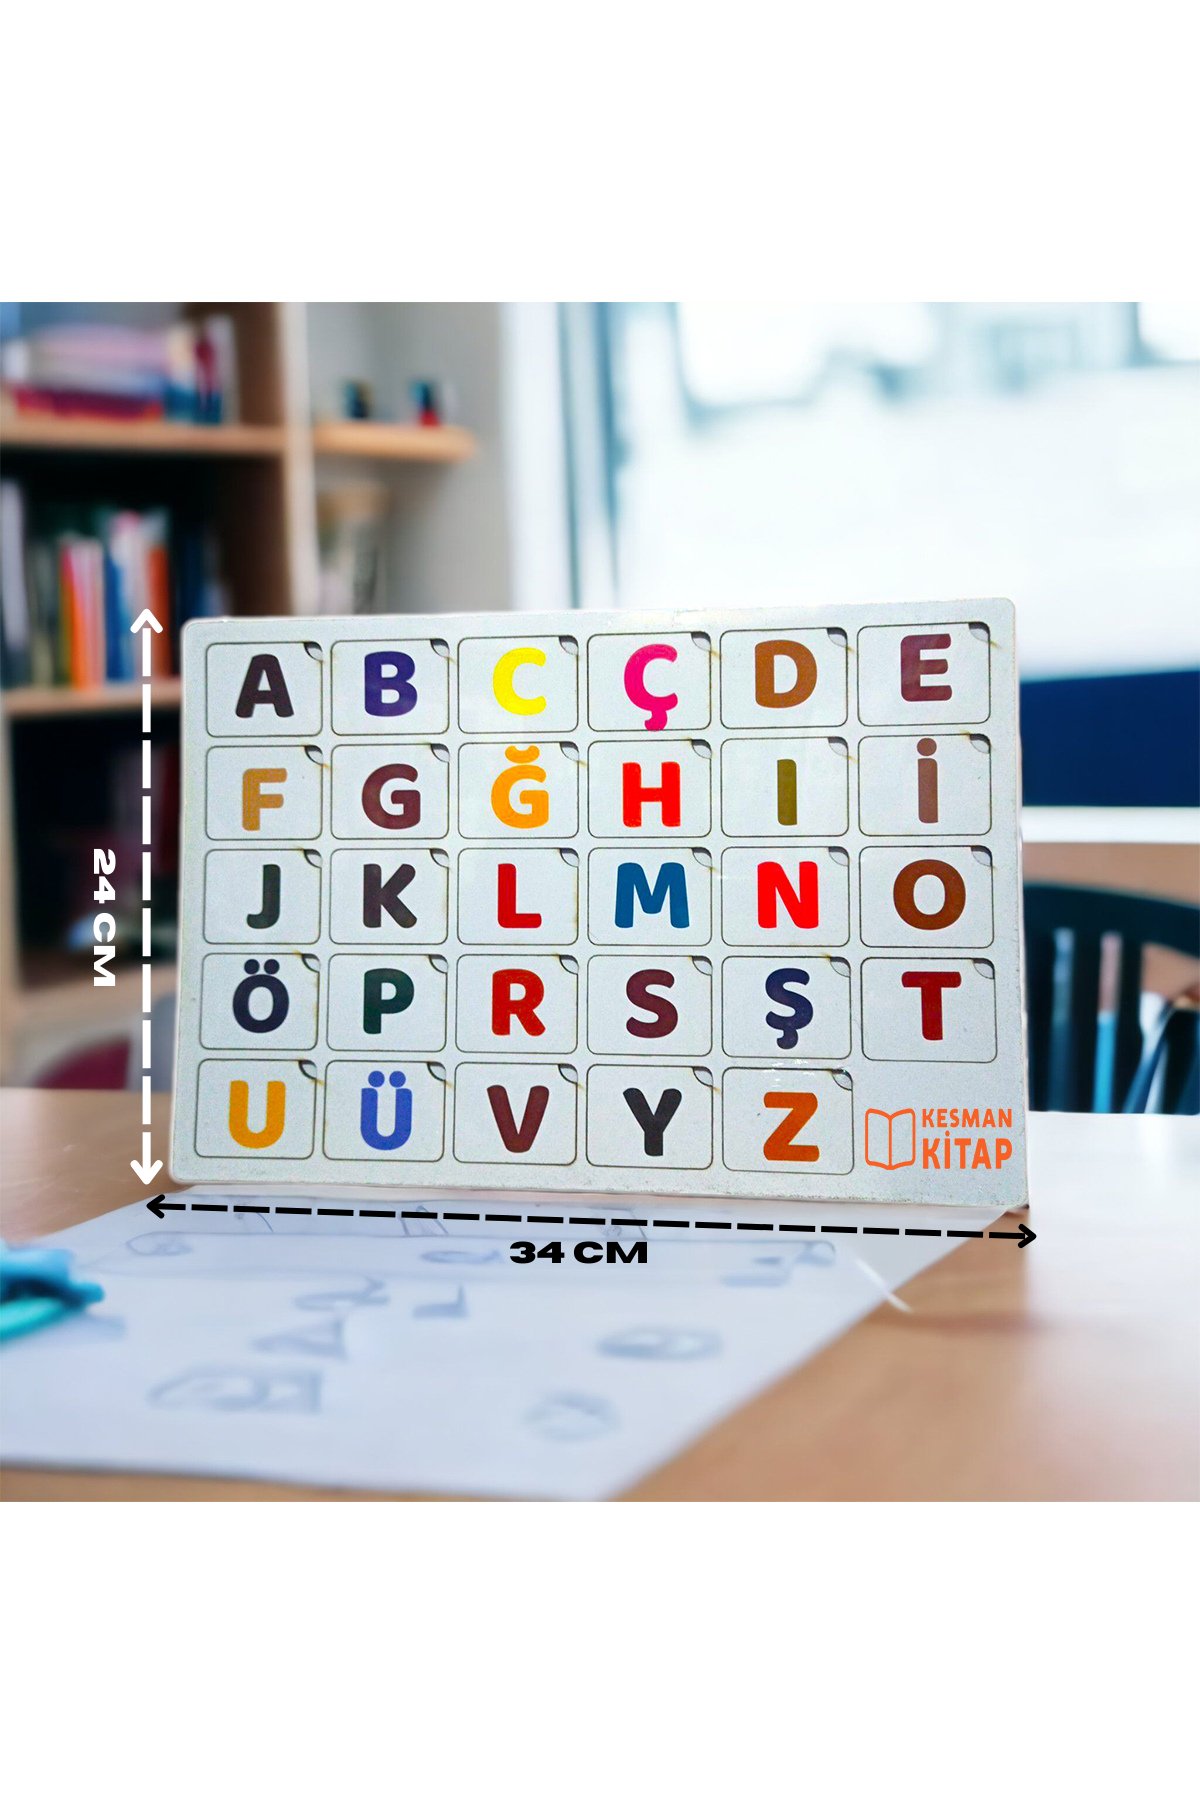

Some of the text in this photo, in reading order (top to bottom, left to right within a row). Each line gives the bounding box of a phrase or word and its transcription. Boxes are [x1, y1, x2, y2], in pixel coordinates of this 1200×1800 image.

[235, 633, 952, 731] A B C Ç D E
[242, 738, 939, 831] F G Ğ H I İ
[246, 859, 966, 930] J K L M N O
[233, 958, 962, 1050] Ö P R S Ş T
[228, 1071, 820, 1162] U Ü V Y Z
